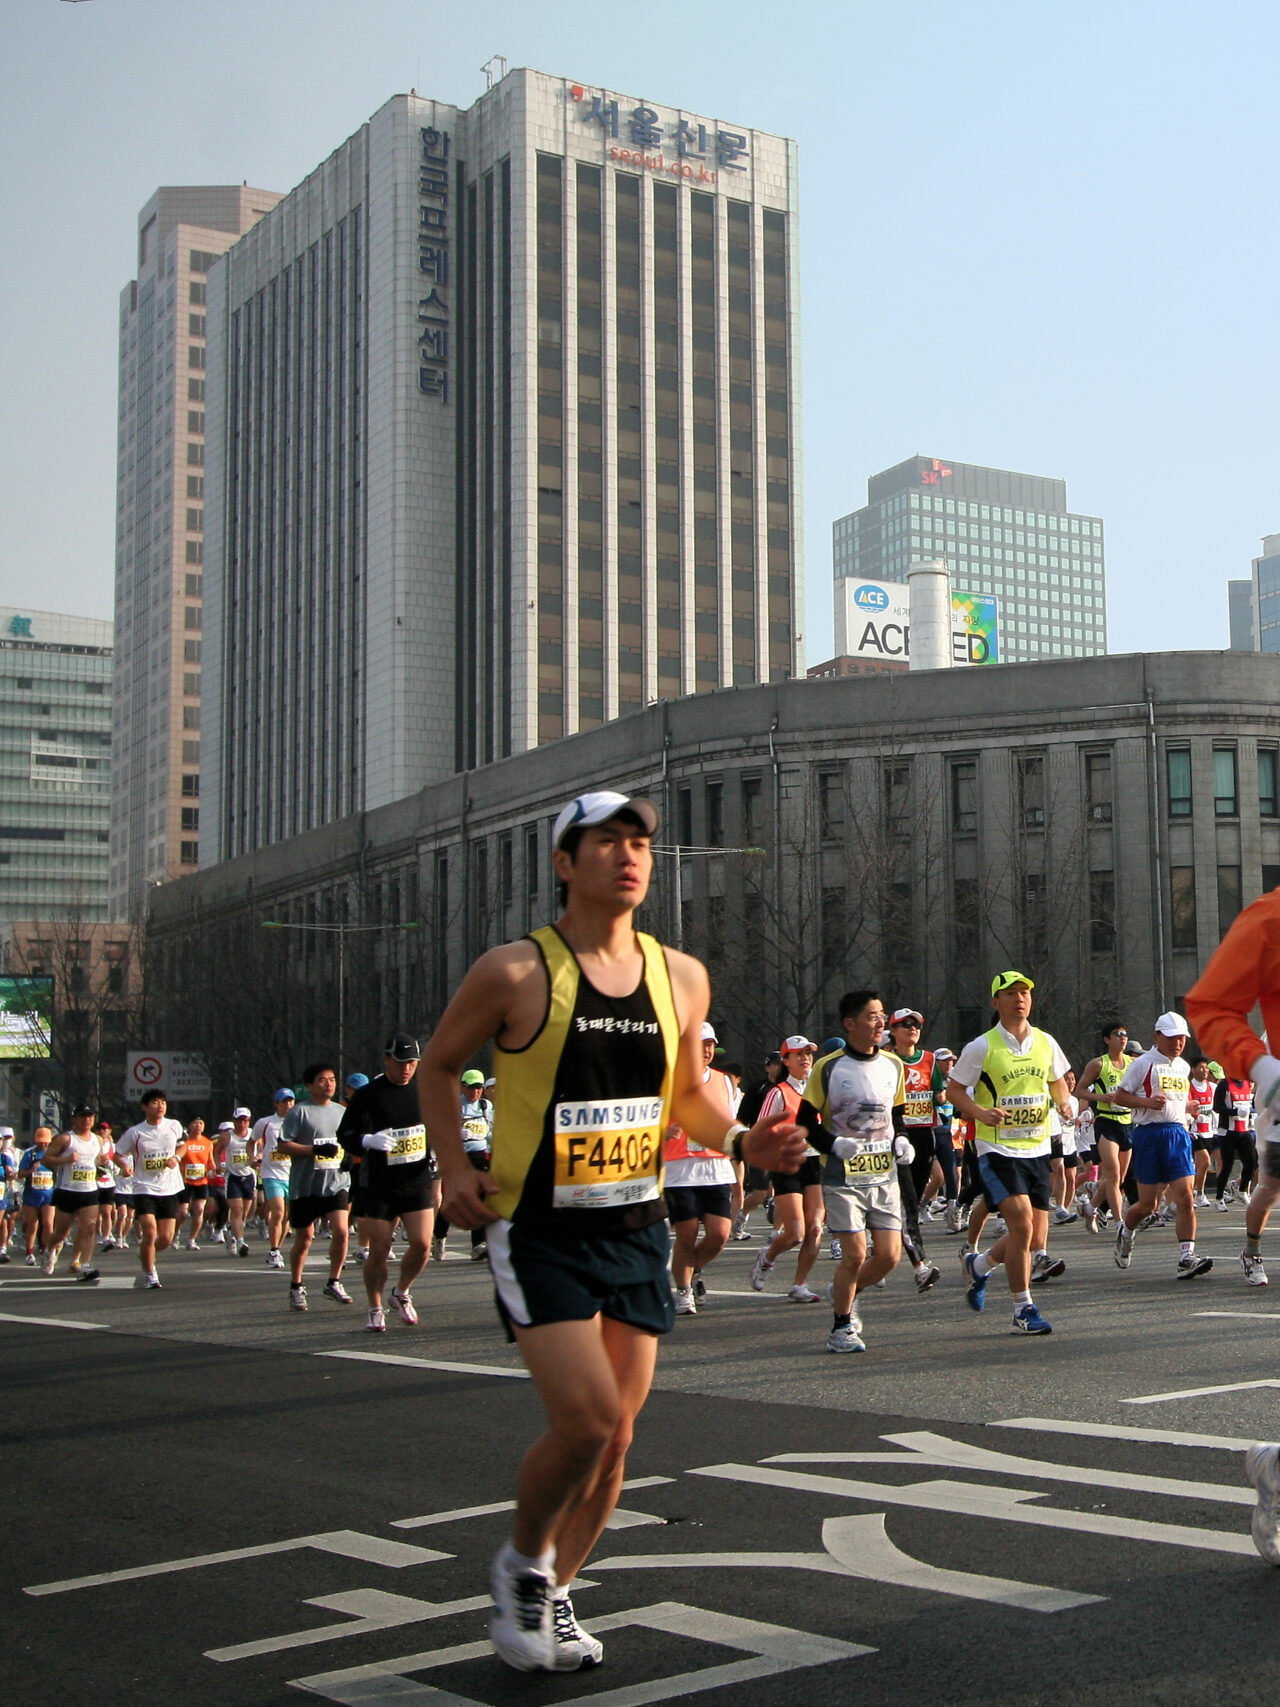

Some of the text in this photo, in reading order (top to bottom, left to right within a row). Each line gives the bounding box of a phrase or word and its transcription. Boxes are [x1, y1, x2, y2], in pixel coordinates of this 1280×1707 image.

[583, 95, 750, 172] 서울신문
[609, 145, 719, 184] seoul.co.kr
[417, 125, 450, 405] 한국프레스센터
[921, 470, 939, 486] SK
[858, 590, 885, 607] ACE
[952, 632, 989, 664] ED
[575, 1016, 659, 1035] 동대문달리기
[1001, 1095, 1045, 1106] SAMSUNG
[559, 1103, 661, 1127] SAMSUNG
[1003, 1108, 1043, 1126] E4252
[567, 1131, 653, 1178] F4406
[848, 1154, 889, 1172] E2103
[145, 1160, 167, 1170] E207
